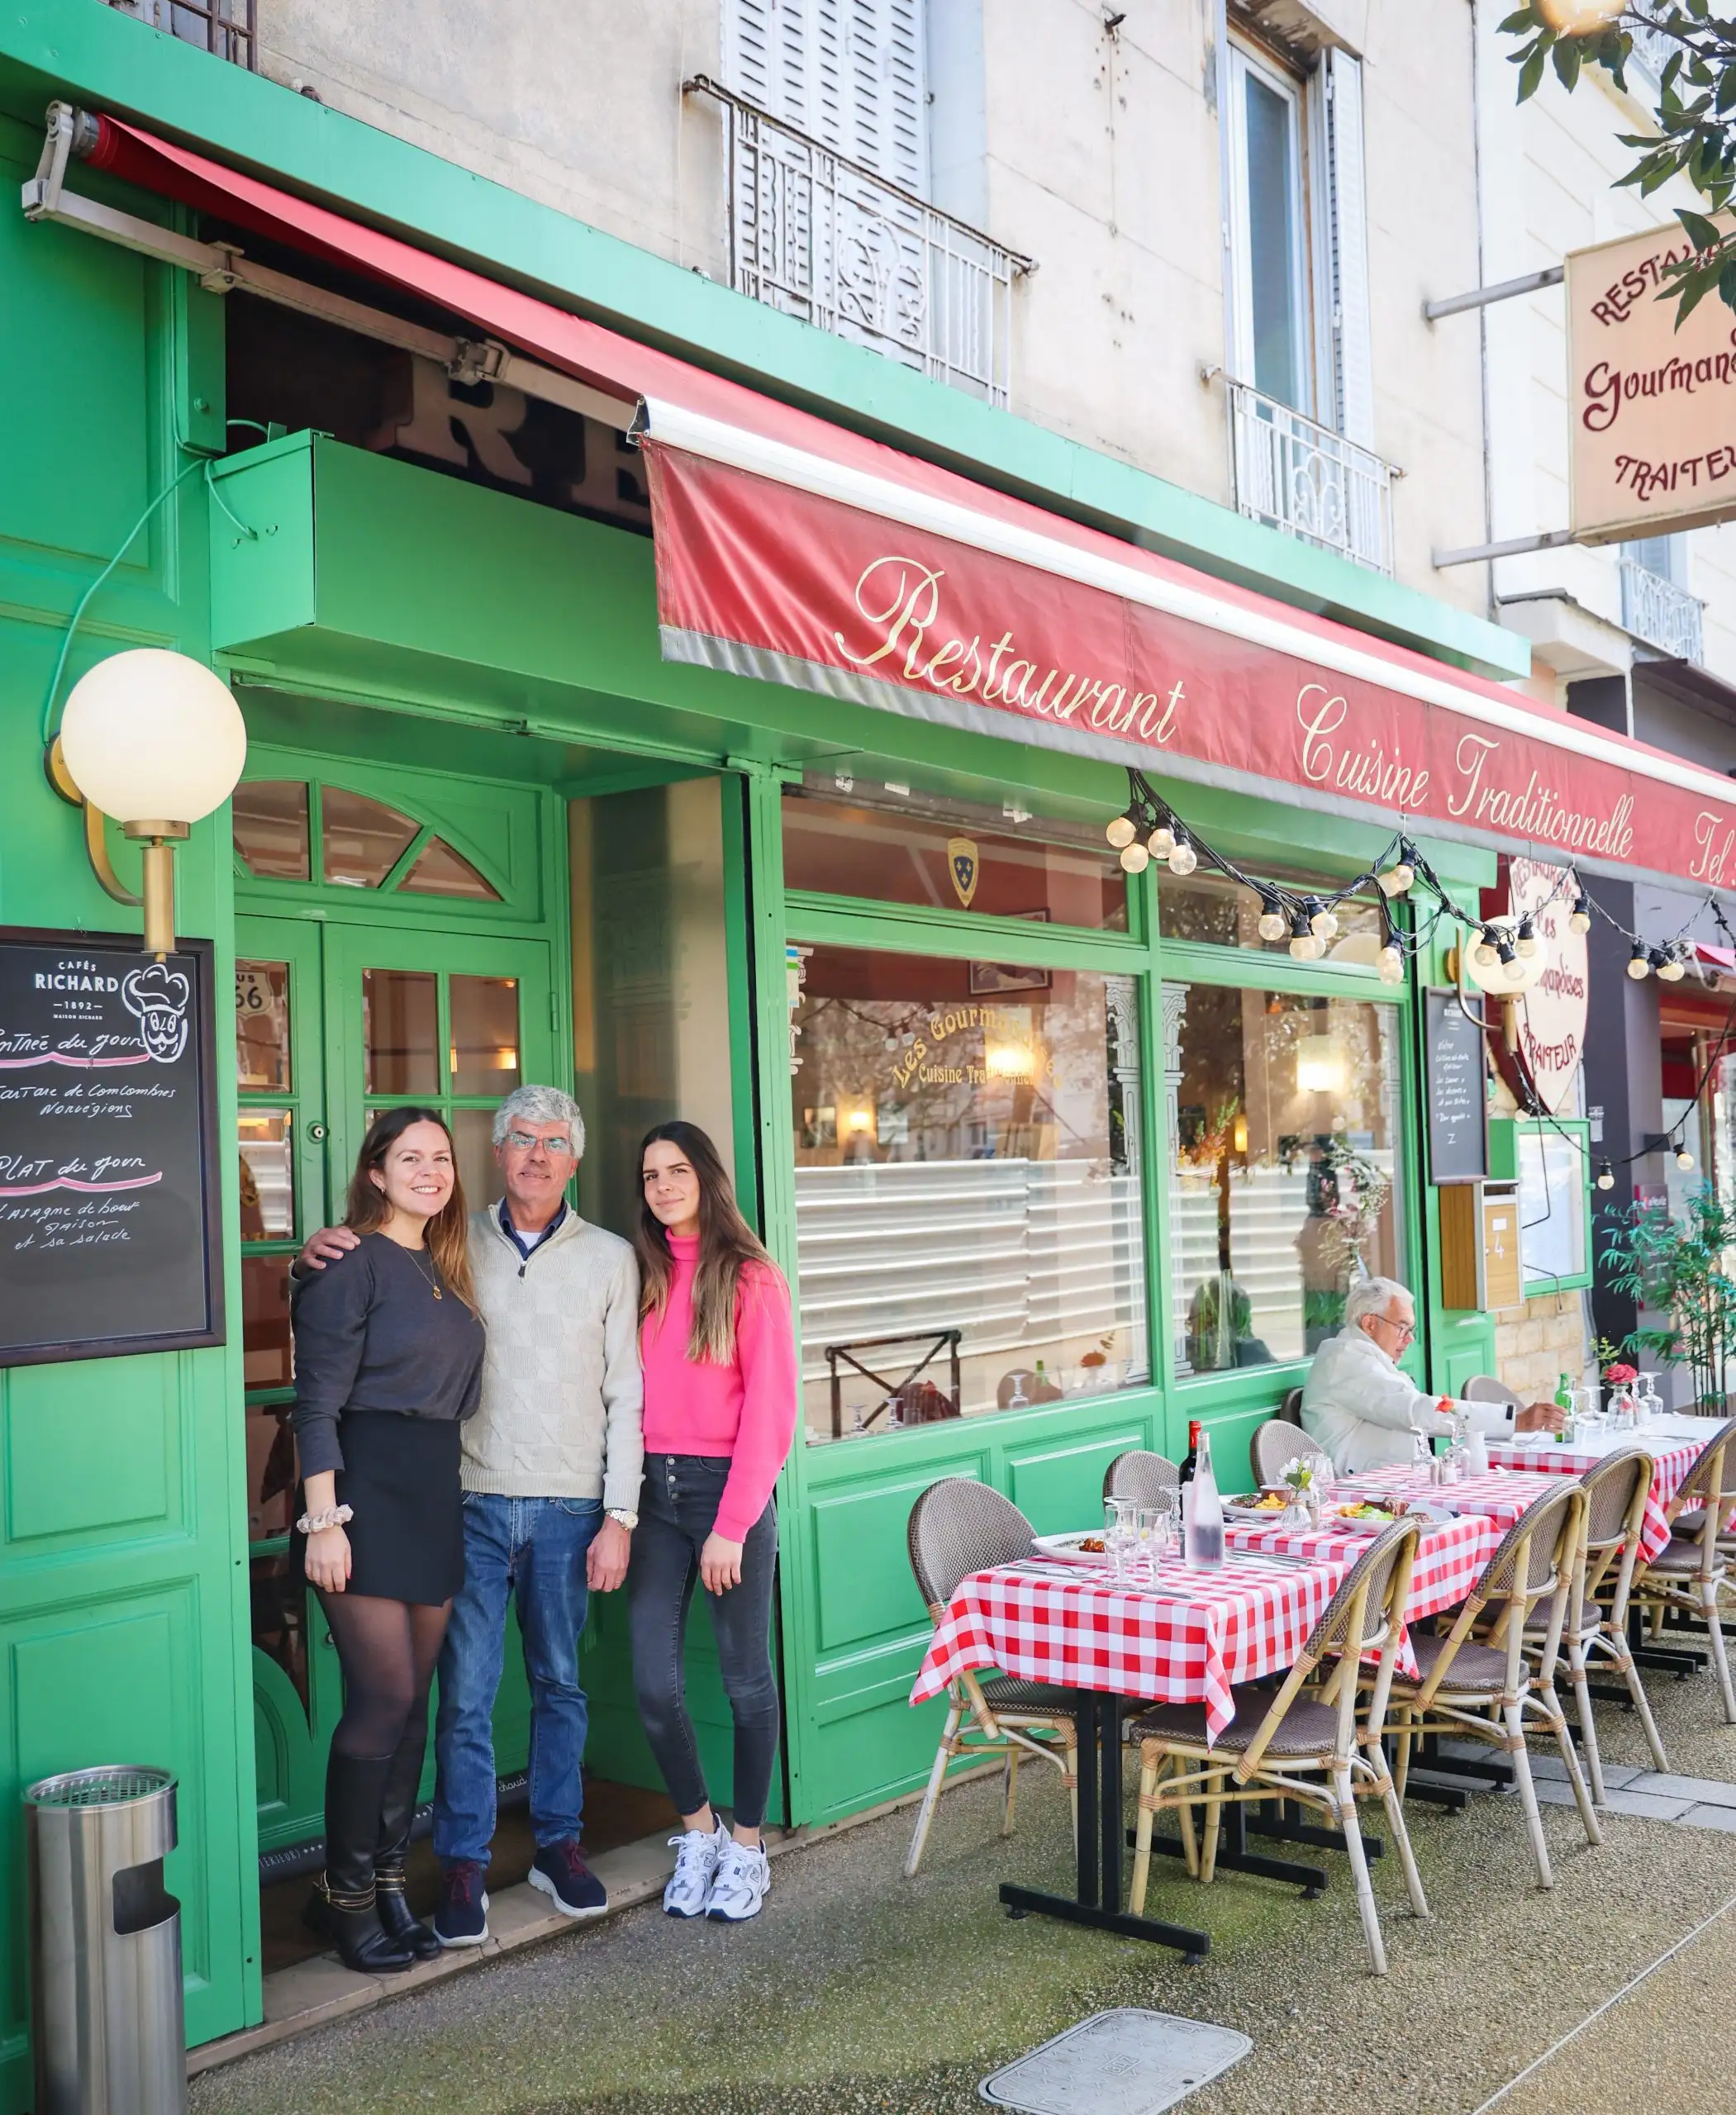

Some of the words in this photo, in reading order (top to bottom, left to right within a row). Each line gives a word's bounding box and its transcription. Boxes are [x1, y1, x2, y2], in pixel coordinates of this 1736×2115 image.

[834, 556, 1187, 744] Restaurant
[1297, 683, 1429, 807] Cuisine
[1448, 734, 1634, 858] Traditionnelle
[58, 960, 97, 972] CAFÉS
[35, 973, 119, 992] RICHARD
[58, 1034, 88, 1049] du
[893, 1038, 927, 1089] Les
[919, 1062, 963, 1083] Cuisine
[64, 1084, 83, 1097] de
[58, 1157, 88, 1175] du
[78, 1202, 95, 1215] de
[40, 1238, 65, 1248] sa
[69, 1229, 131, 1245] salade
[1494, 1232, 1505, 1260] 4
[498, 1775, 528, 1792] chaud
